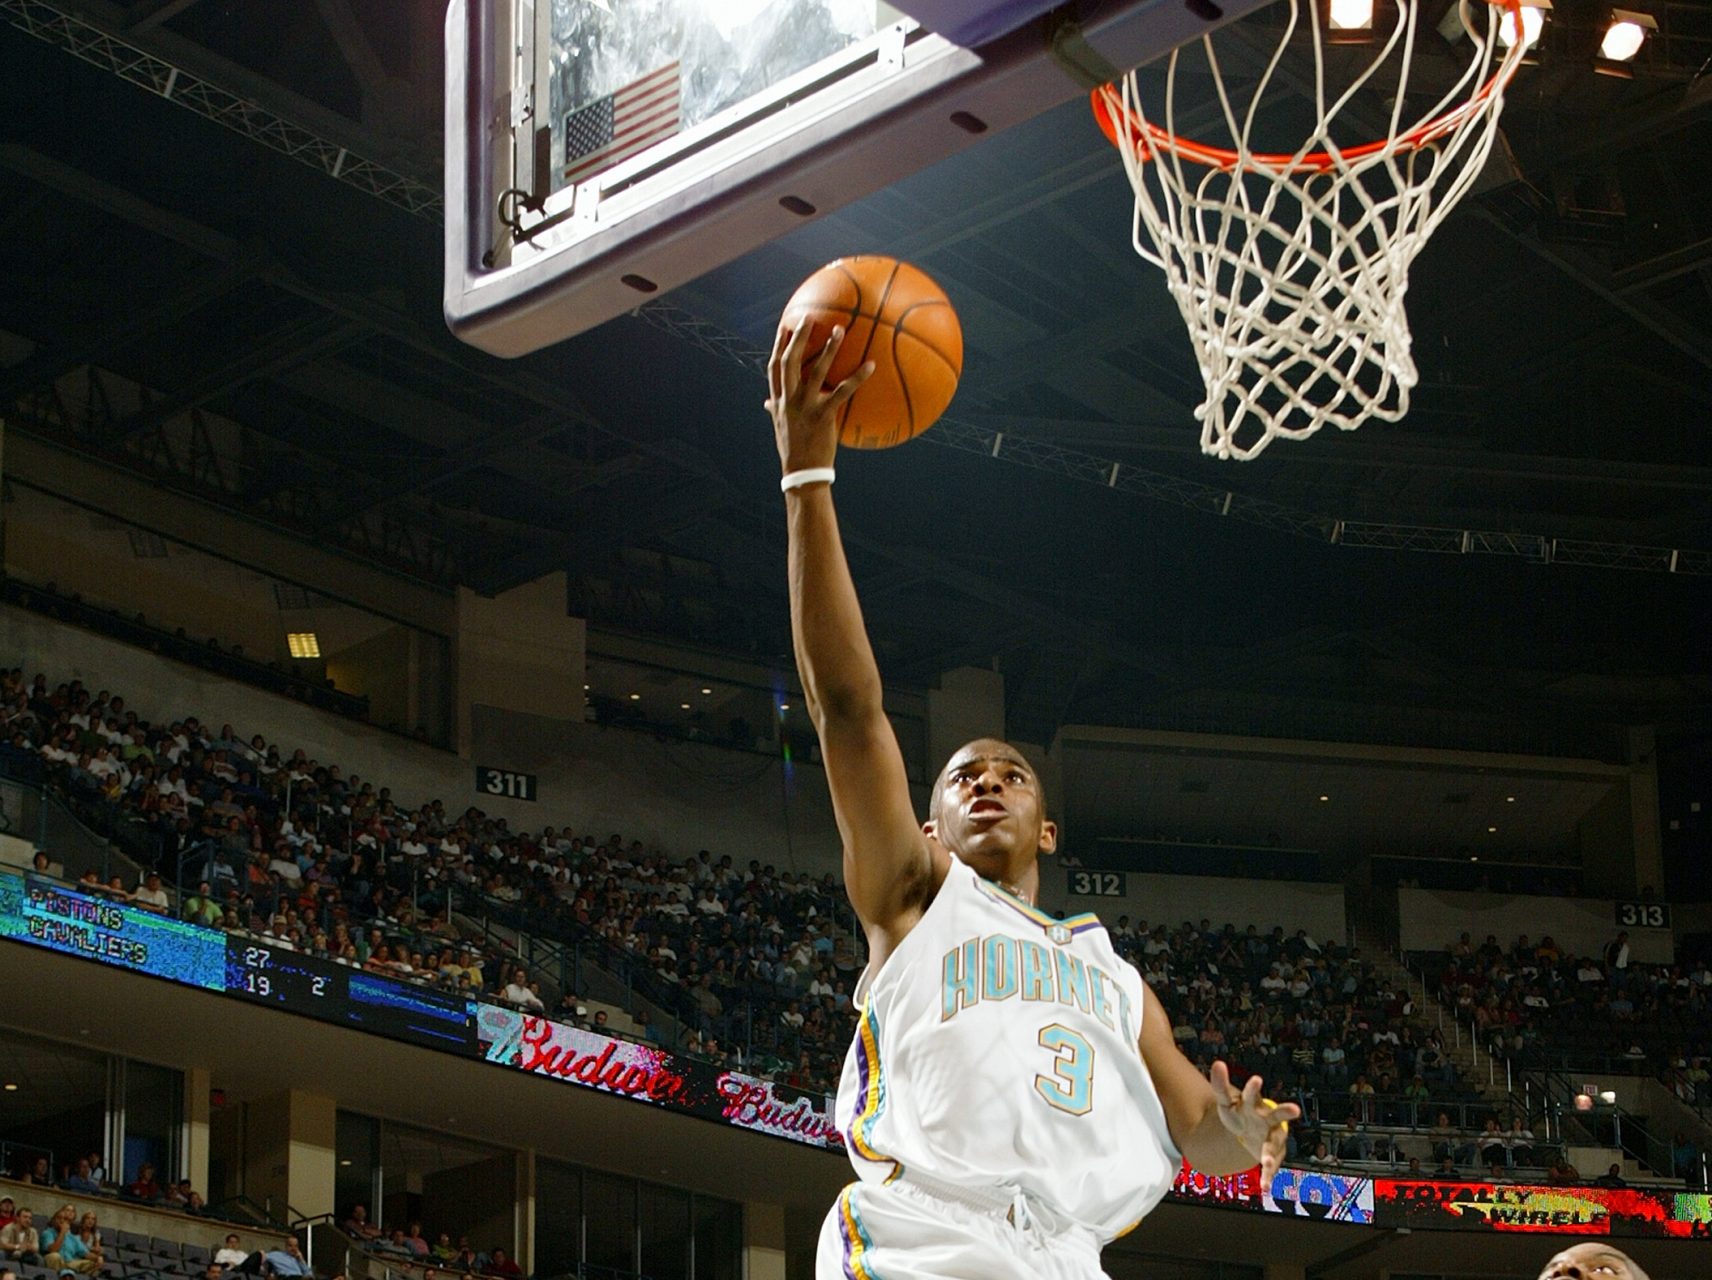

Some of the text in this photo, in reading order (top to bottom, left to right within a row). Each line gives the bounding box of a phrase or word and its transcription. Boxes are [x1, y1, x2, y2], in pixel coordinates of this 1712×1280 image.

[487, 770, 527, 798] 311
[1075, 873, 1120, 896] 312
[31, 888, 122, 930] PISTONS
[1622, 904, 1664, 926] 313
[30, 915, 147, 963] CAVALIERS
[246, 946, 270, 968] 27
[247, 973, 270, 996] 19
[312, 976, 325, 996] 2
[1034, 1022, 1095, 1117] 3
